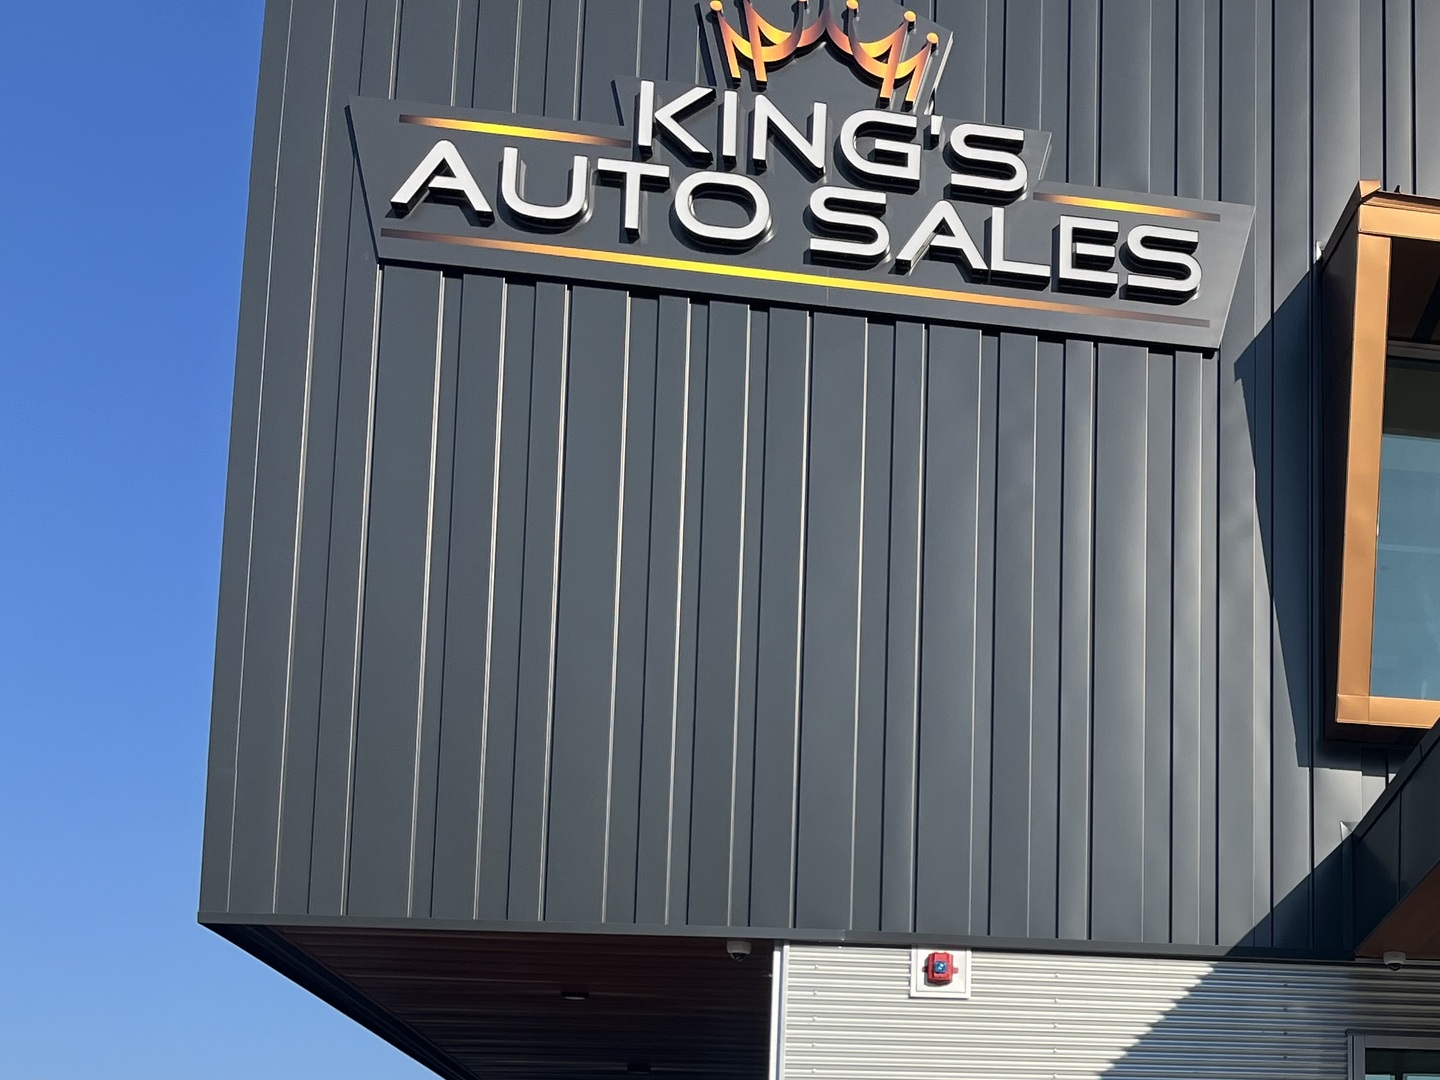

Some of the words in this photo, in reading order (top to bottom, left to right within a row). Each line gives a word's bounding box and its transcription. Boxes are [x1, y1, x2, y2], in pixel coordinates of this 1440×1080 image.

[637, 79, 1030, 200] KING'S
[389, 139, 773, 246] AUTO
[808, 185, 1203, 299] SALES
